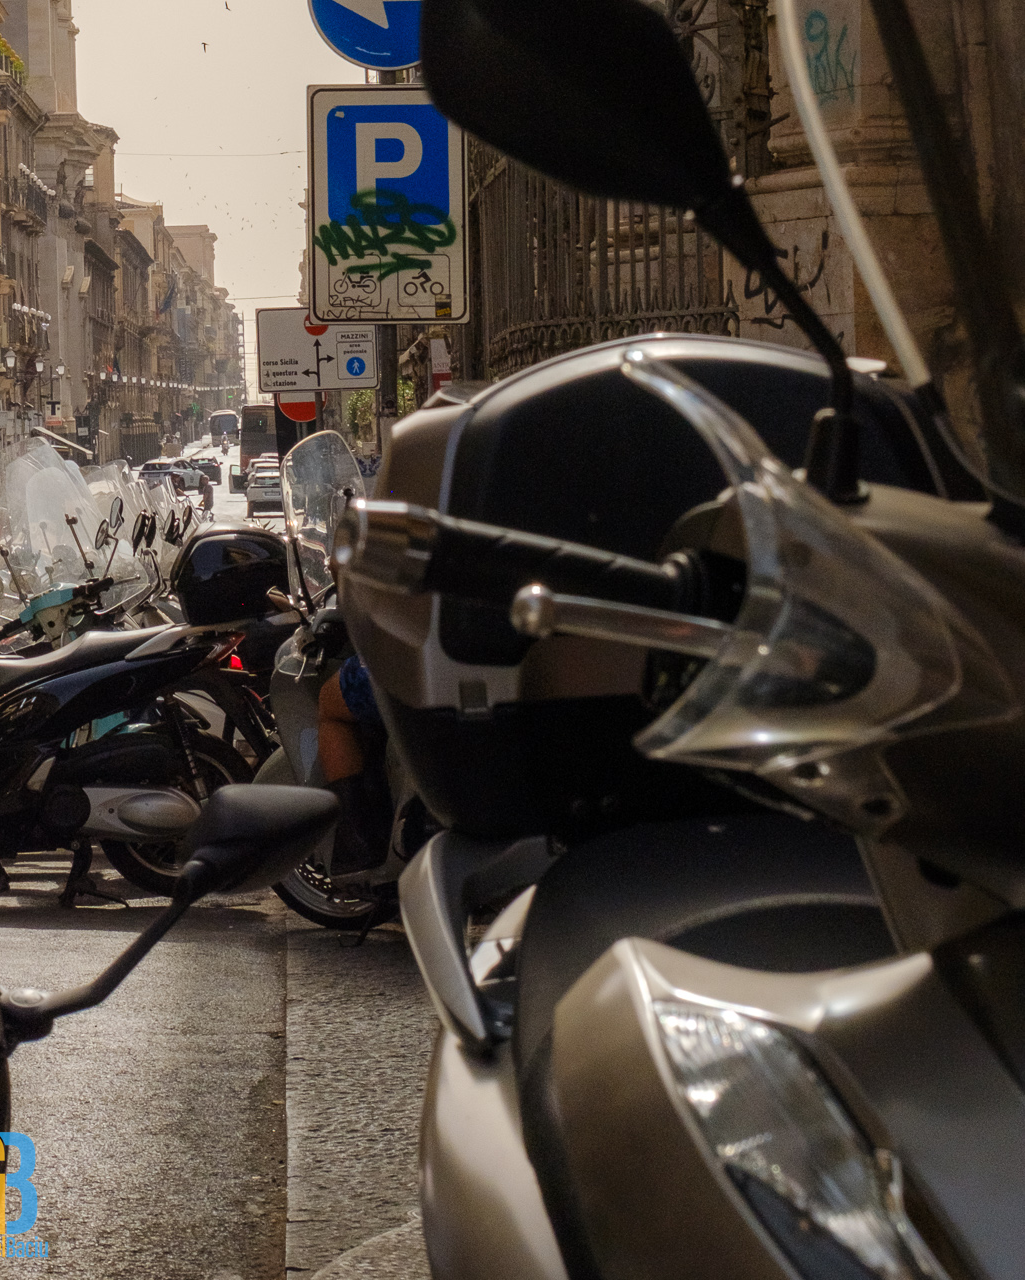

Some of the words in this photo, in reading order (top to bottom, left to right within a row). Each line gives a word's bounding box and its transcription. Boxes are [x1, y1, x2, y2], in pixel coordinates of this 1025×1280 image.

[355, 122, 423, 207] P
[279, 358, 299, 366] Sicilia
[272, 370, 298, 378] questura
